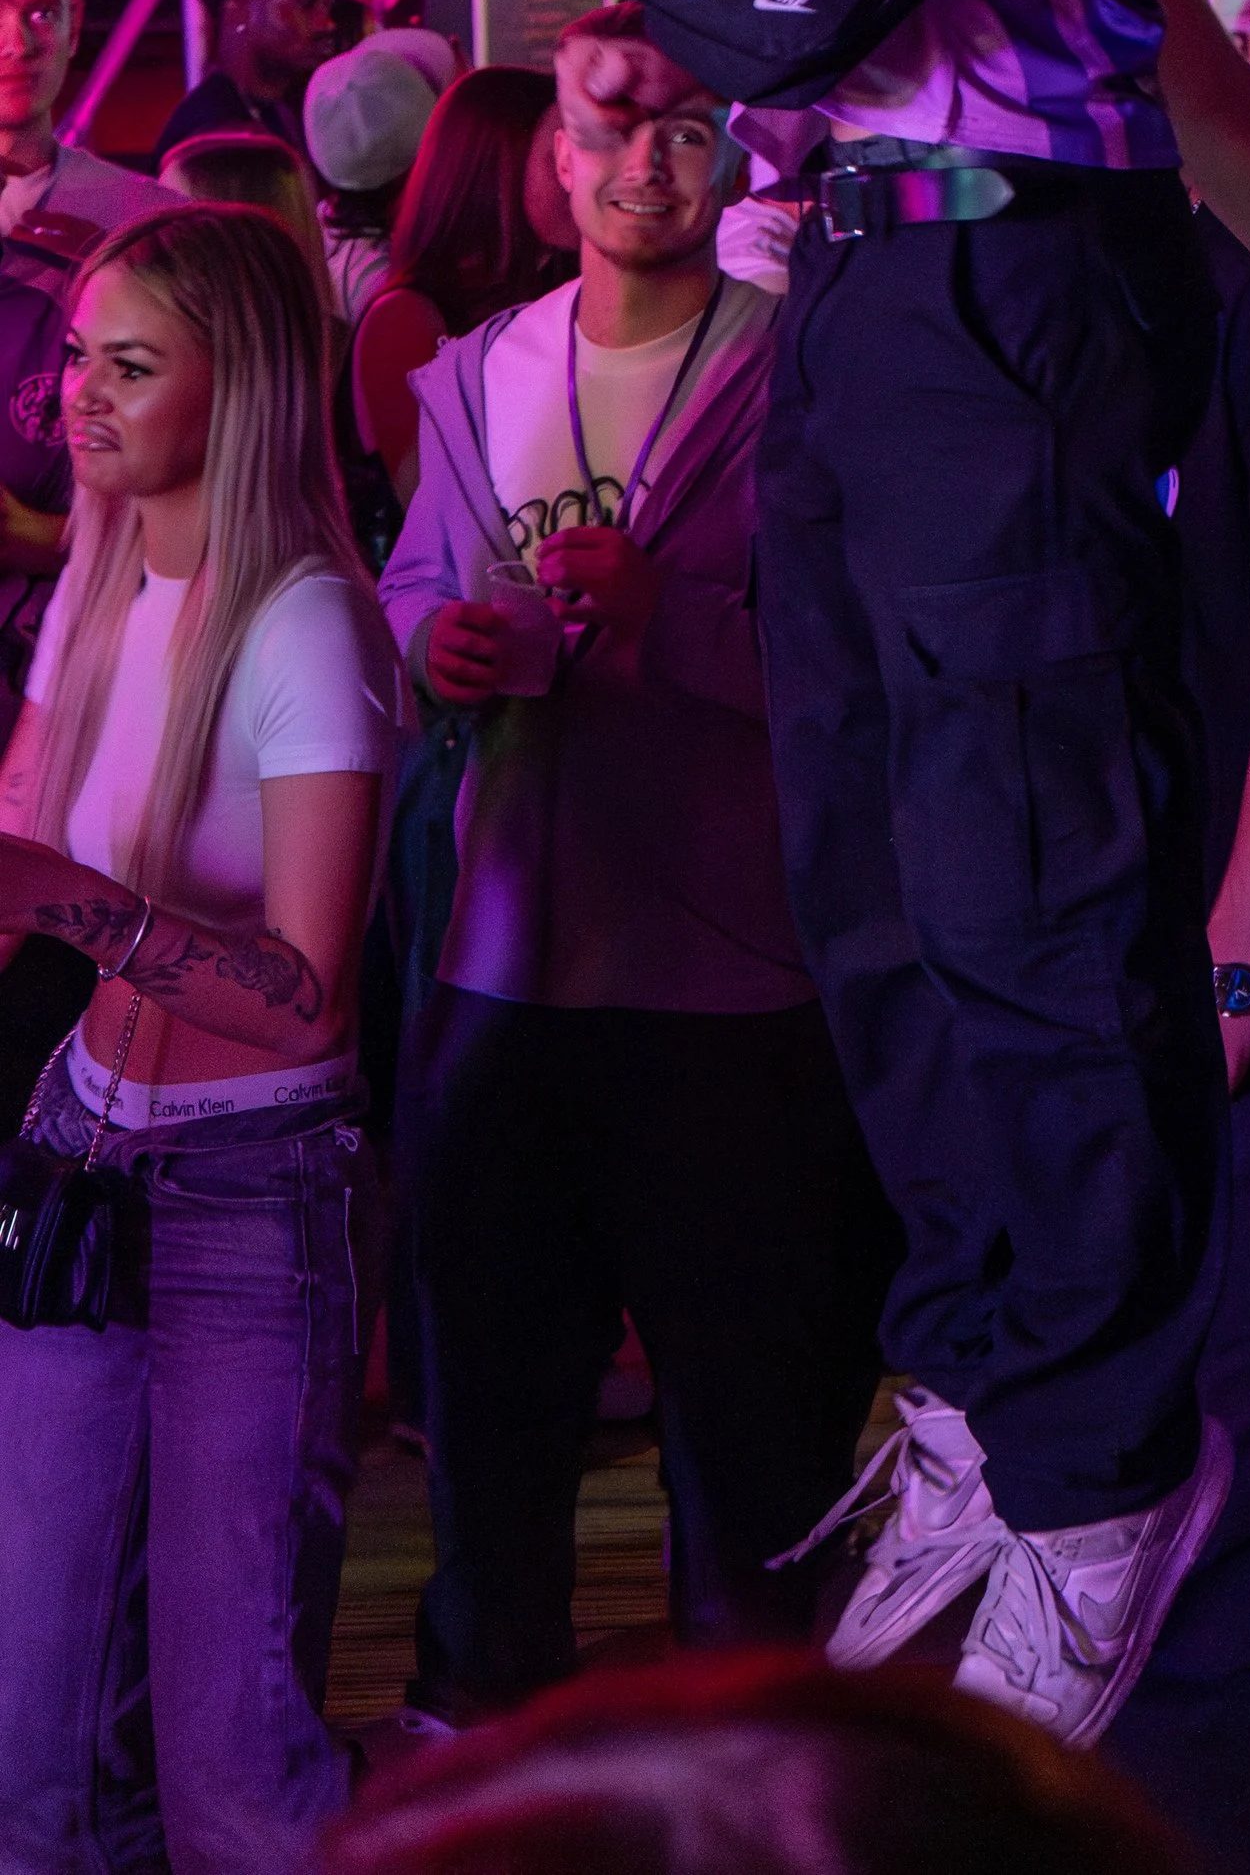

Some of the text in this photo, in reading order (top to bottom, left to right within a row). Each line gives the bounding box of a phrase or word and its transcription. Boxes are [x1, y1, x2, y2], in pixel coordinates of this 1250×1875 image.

[274, 1083, 323, 1104] Calvin
[149, 1097, 236, 1118] Calvin Klein
